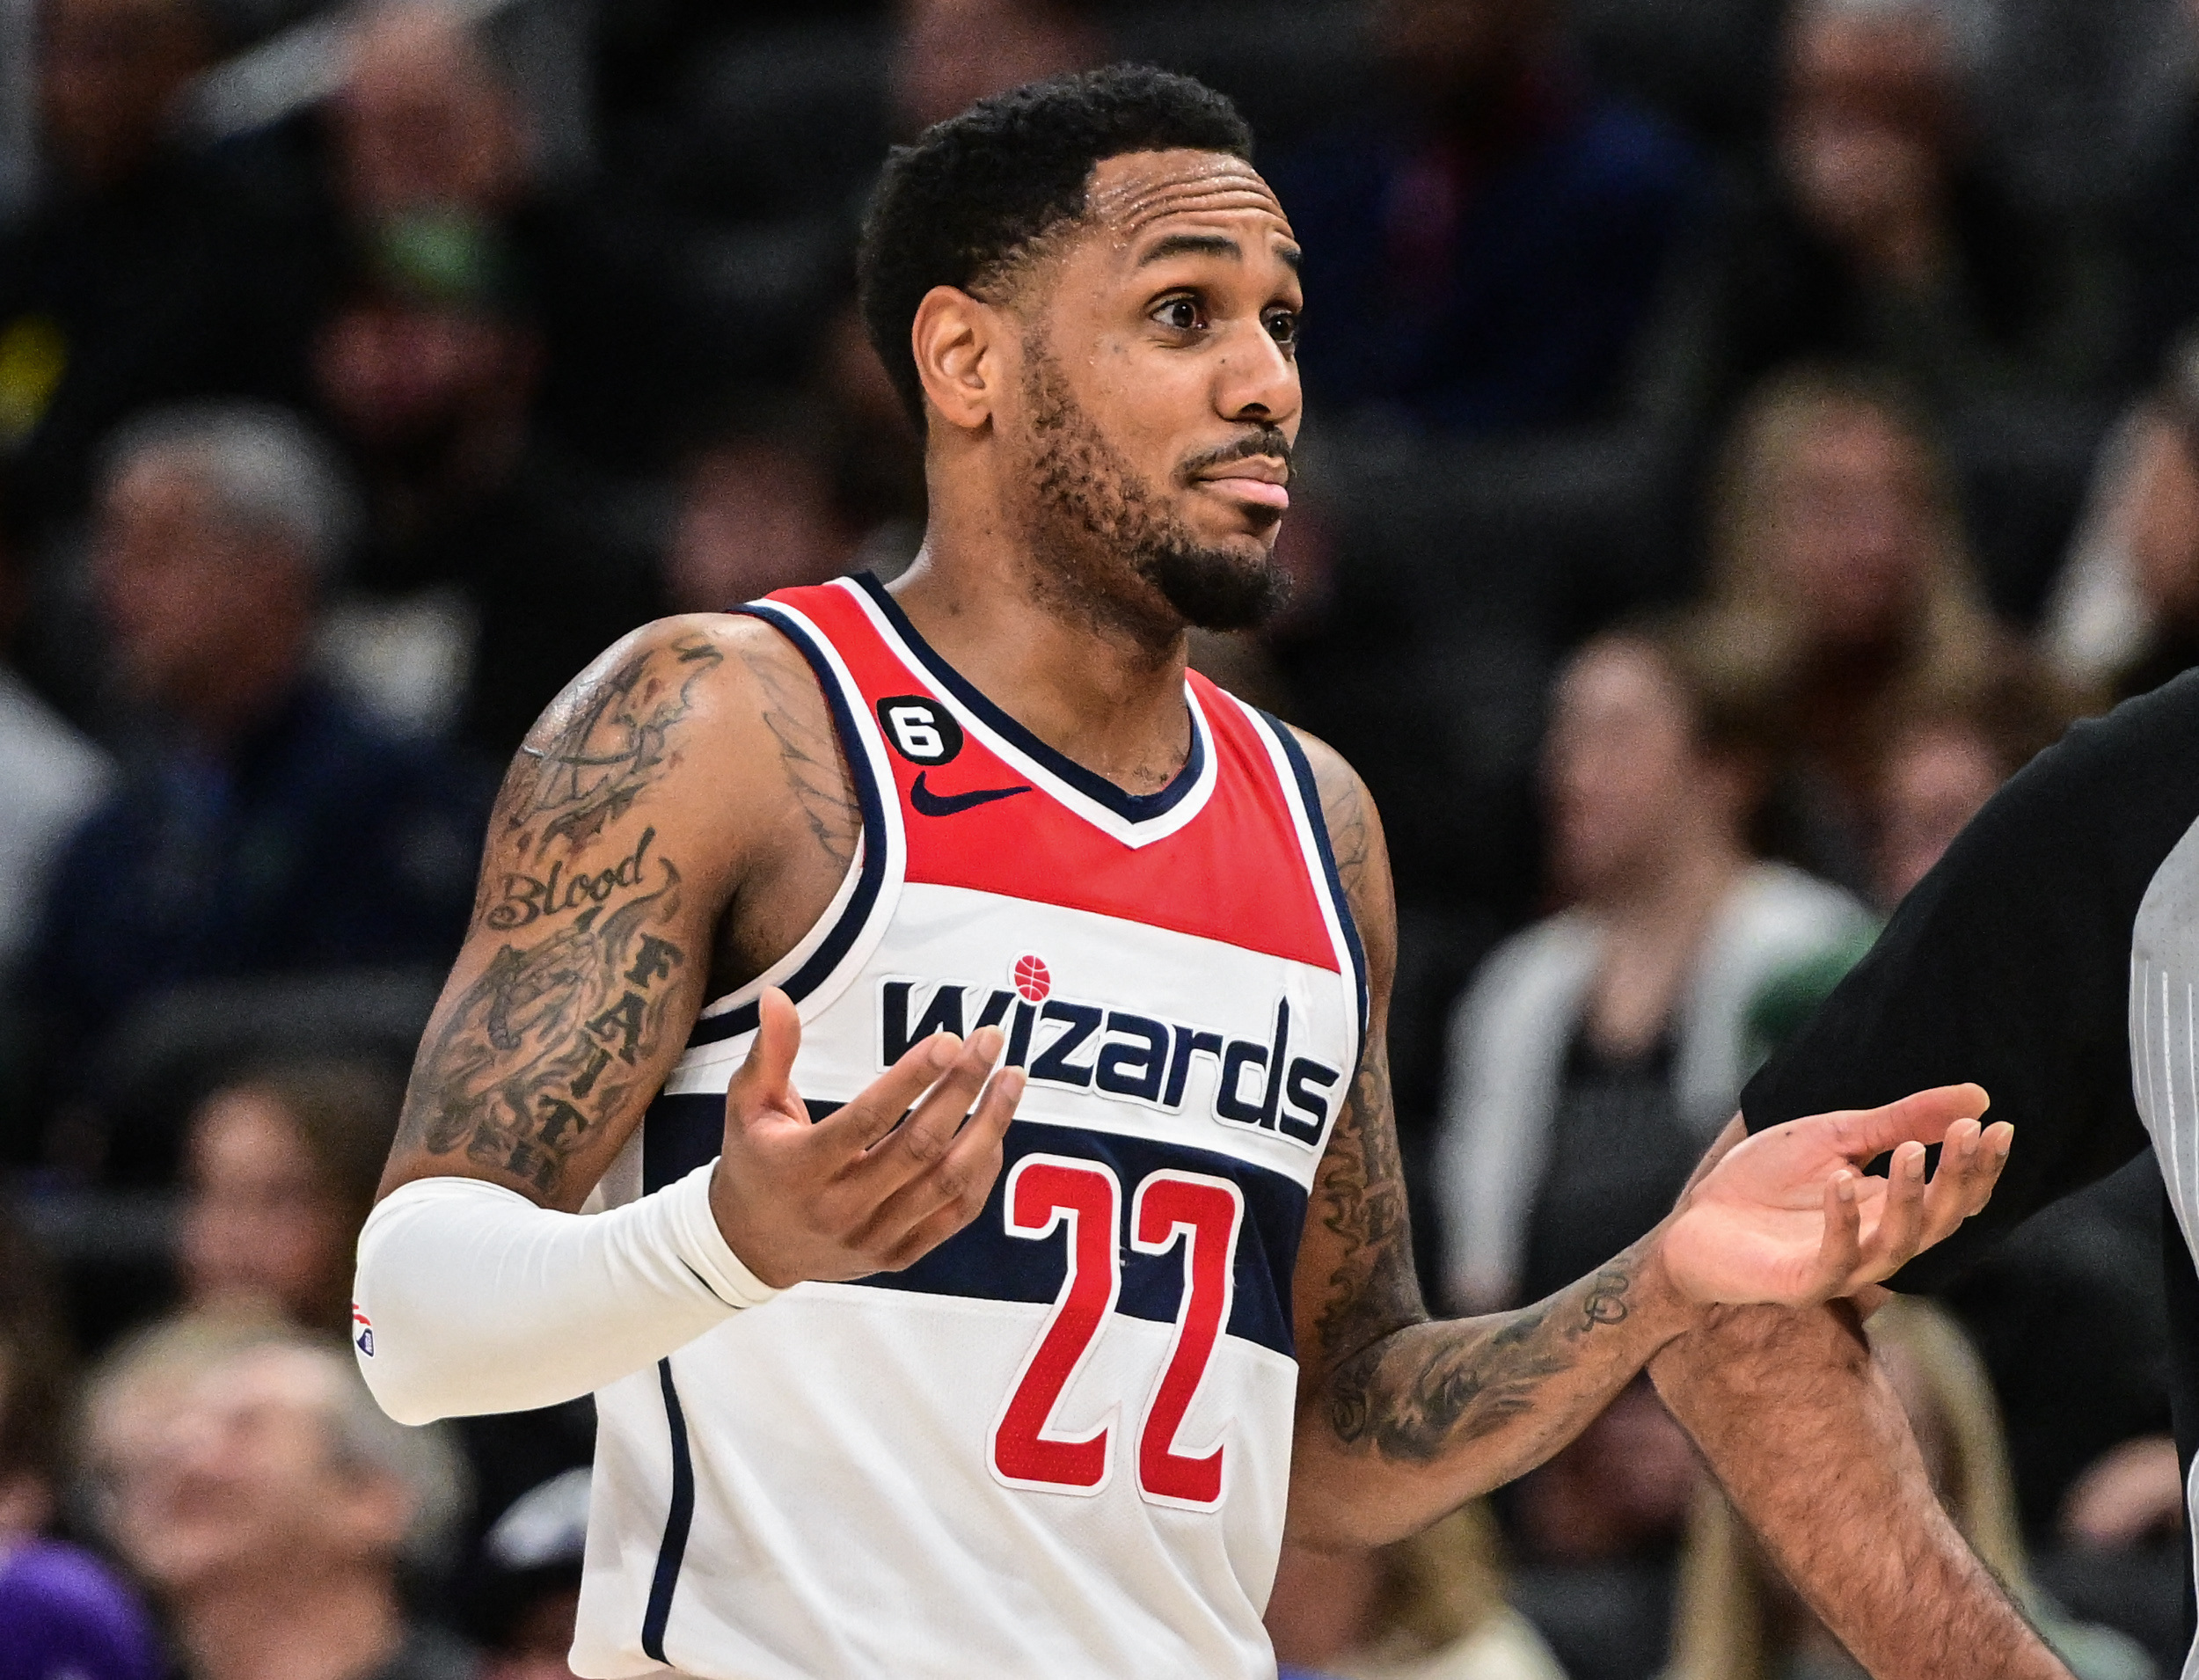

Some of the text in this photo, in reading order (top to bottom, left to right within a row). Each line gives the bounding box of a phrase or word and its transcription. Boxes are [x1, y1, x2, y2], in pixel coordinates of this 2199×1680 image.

[889, 706, 945, 757] 6
[487, 827, 656, 930] Blood
[986, 1152, 1244, 1513] 22
